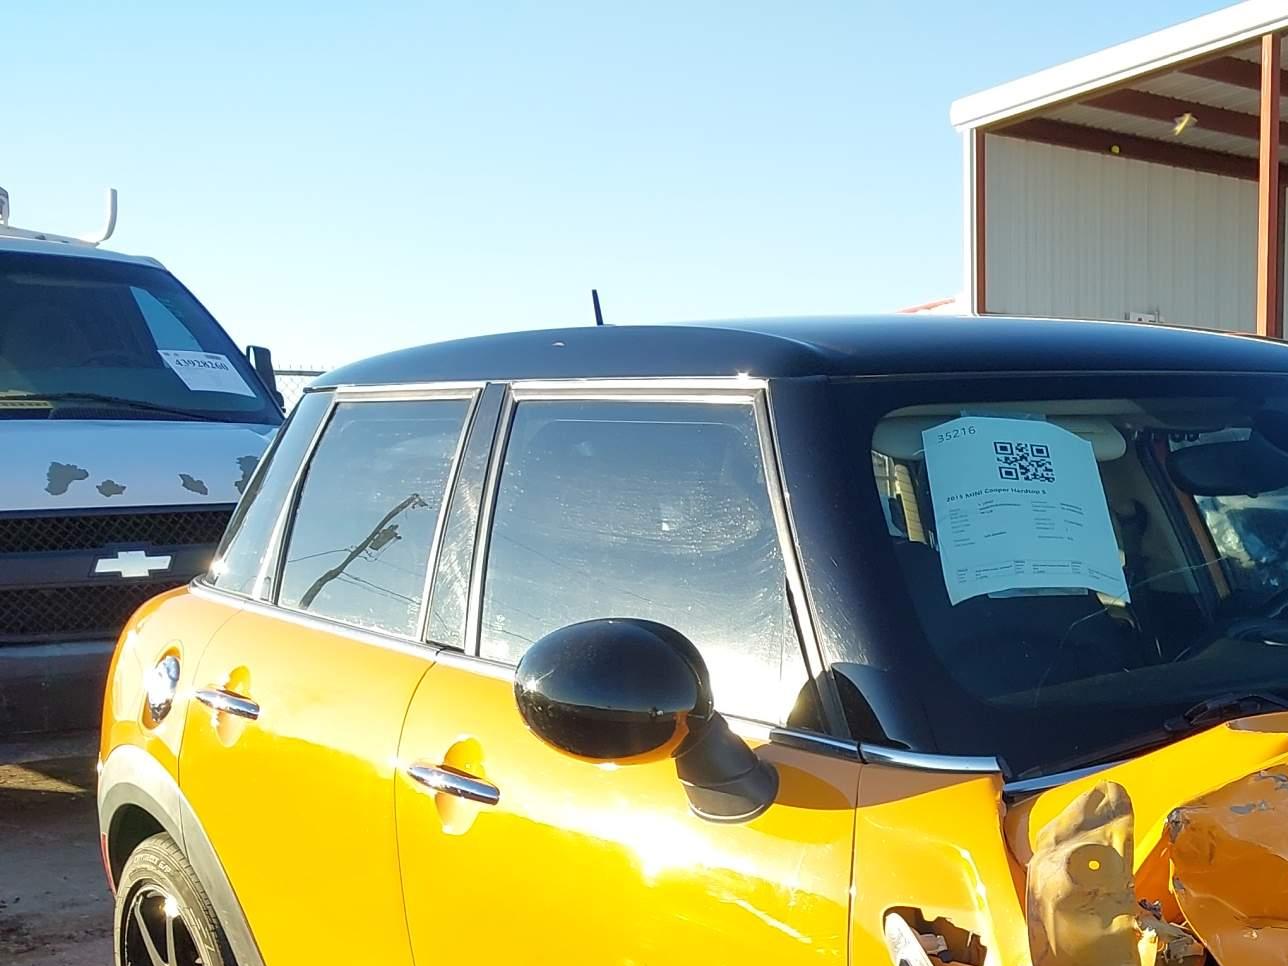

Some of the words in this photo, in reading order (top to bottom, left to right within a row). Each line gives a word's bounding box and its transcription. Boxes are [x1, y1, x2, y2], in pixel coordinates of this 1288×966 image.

[937, 425, 976, 444] 35216
[965, 490, 983, 499] MINI
[984, 487, 1009, 495] Cooper
[1010, 487, 1040, 495] Hardtop
